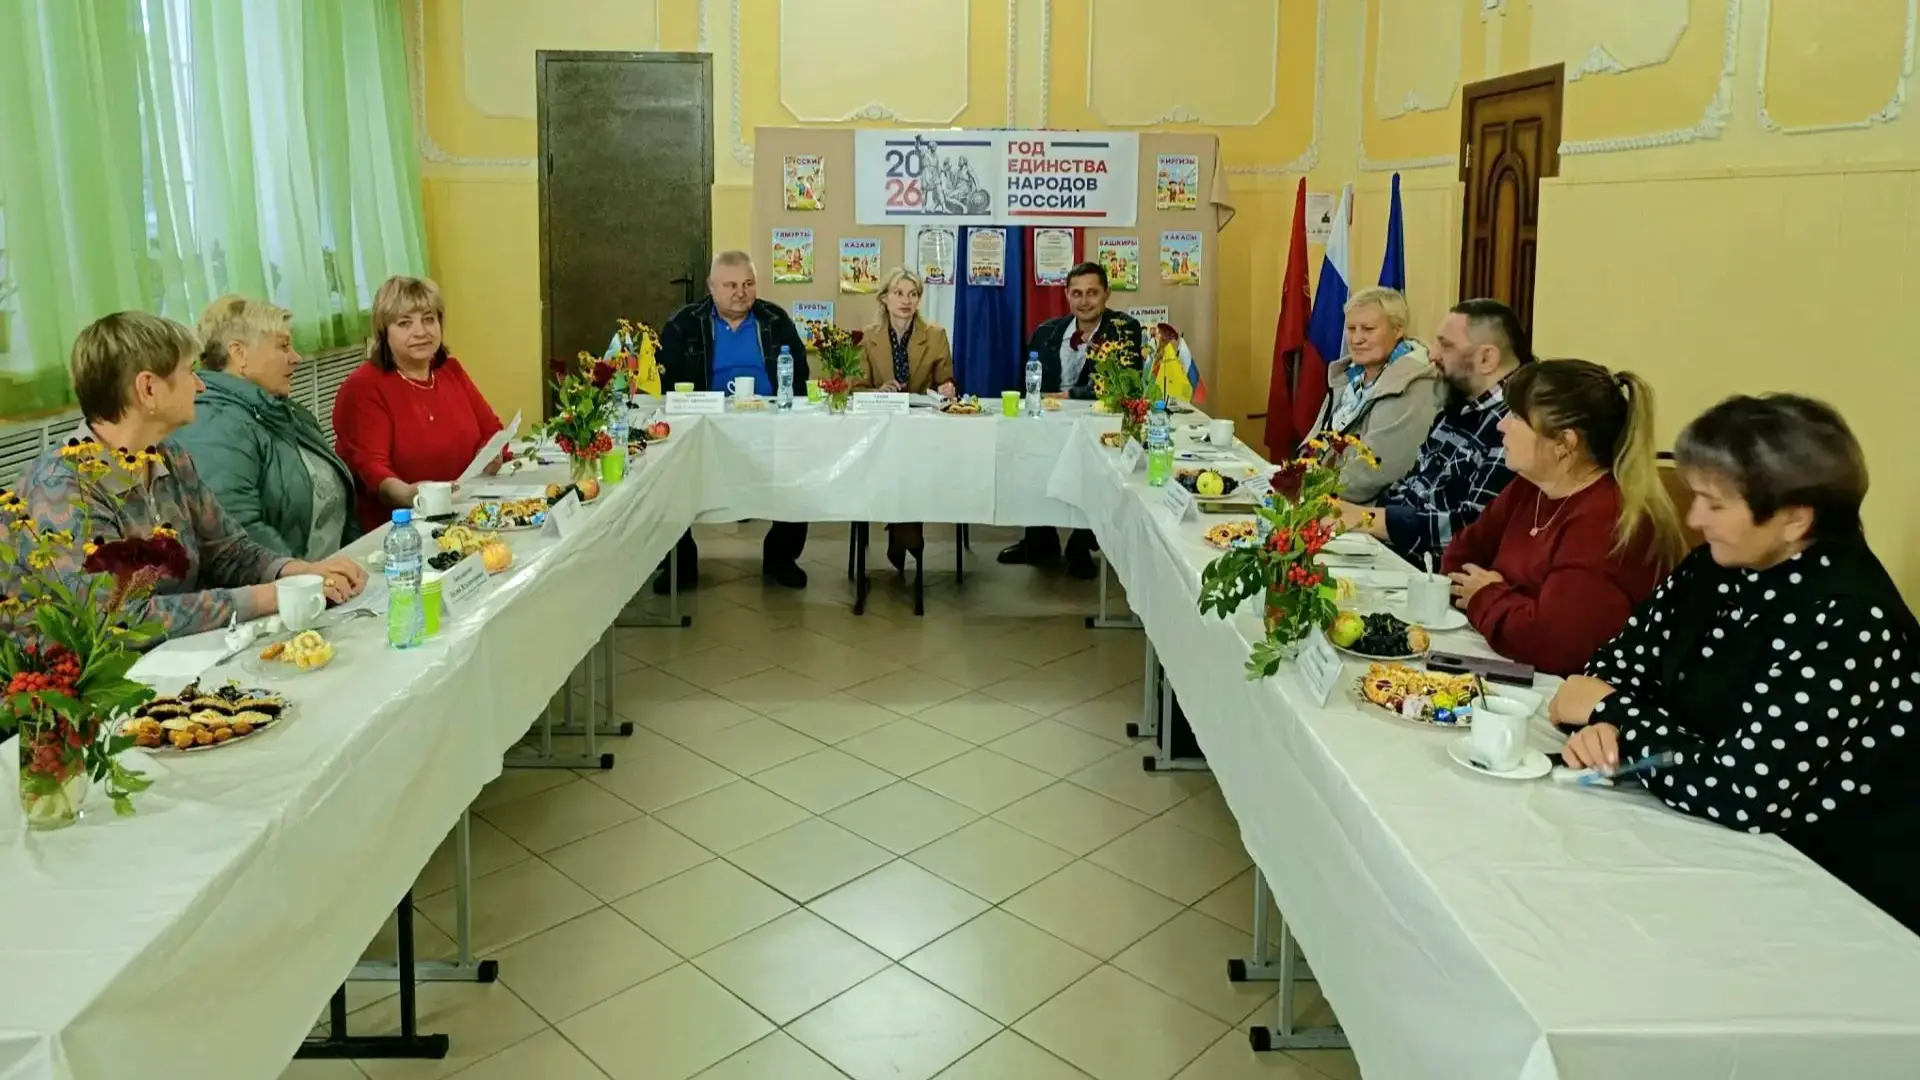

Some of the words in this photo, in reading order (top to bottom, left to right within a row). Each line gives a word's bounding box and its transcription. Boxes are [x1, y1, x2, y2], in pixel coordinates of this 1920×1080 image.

[1008, 141, 1045, 157] ГОД
[885, 150, 922, 178] 20
[1008, 159, 1108, 174] ЕДИНСТВА
[1008, 177, 1098, 192] НАРОДОВ
[885, 179, 922, 206] 26
[1008, 194, 1085, 208] РОССИИ
[1130, 308, 1166, 316] КАЛМЫКИ
